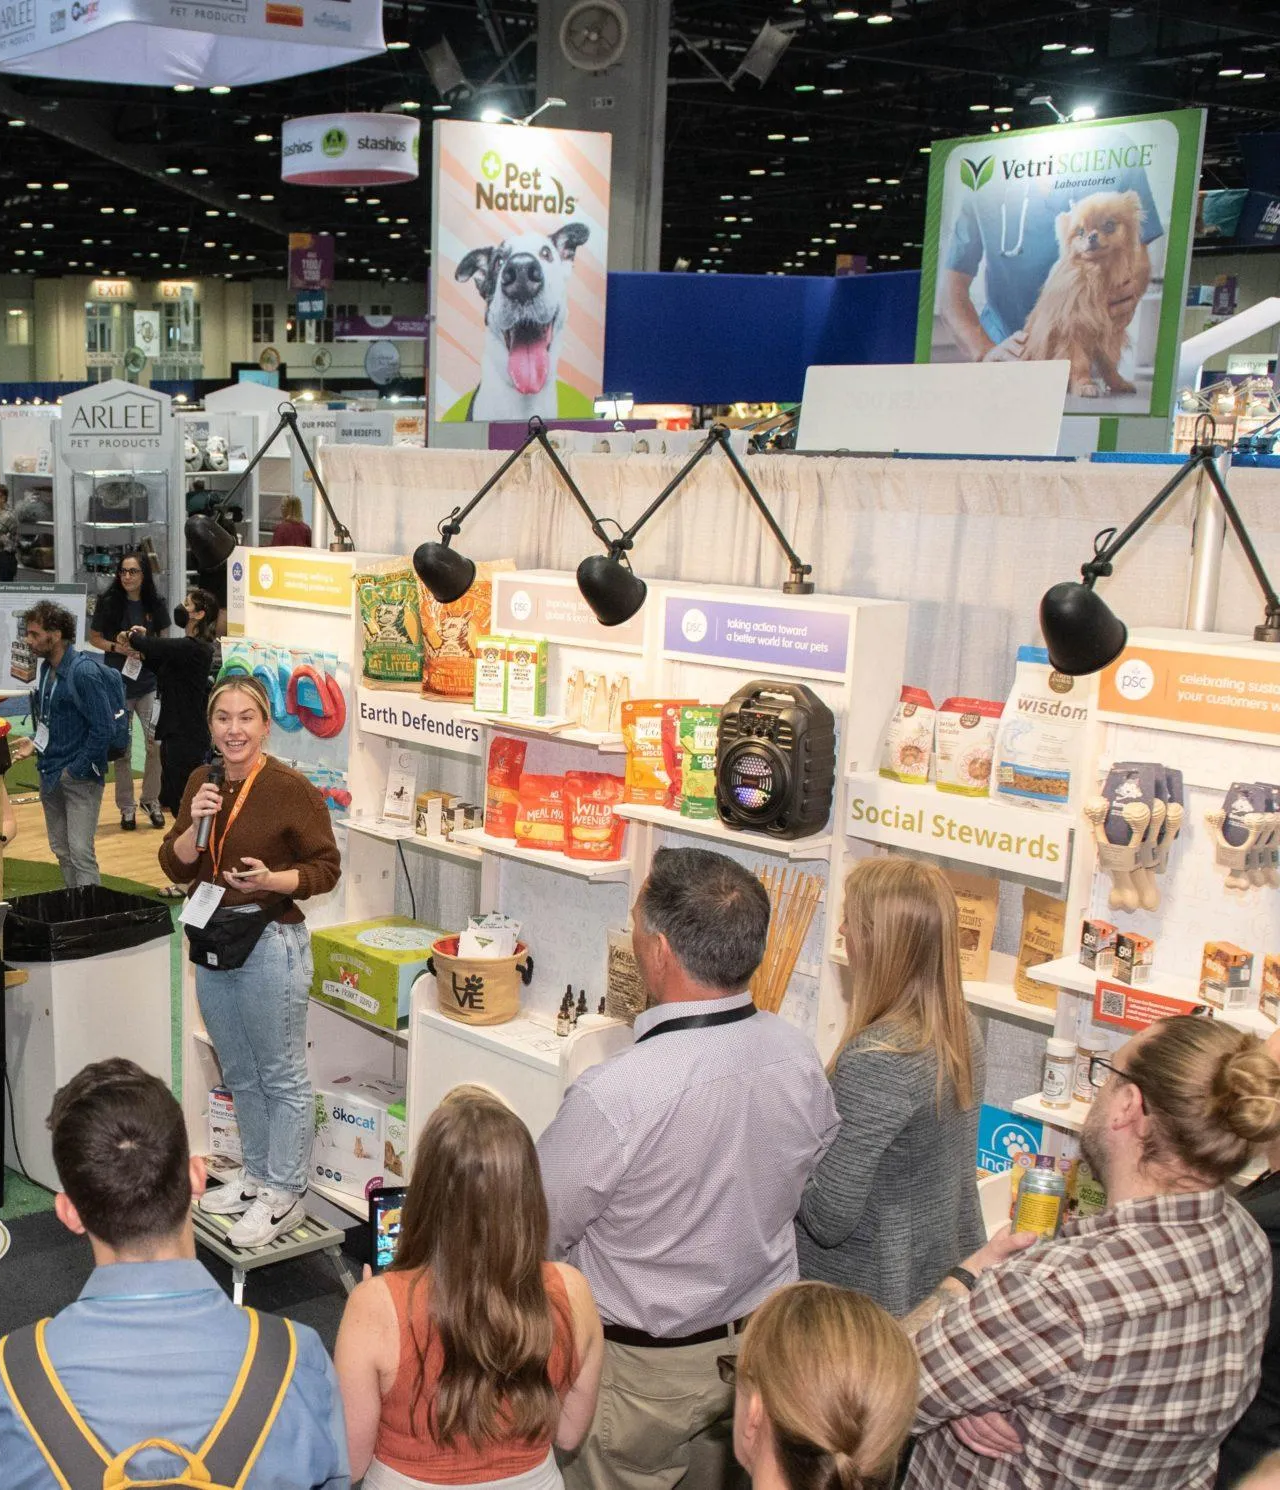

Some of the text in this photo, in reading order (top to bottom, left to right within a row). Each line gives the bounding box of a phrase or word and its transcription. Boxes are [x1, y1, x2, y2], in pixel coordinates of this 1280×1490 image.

[170, 7, 247, 24] PET PRODUCTS
[357, 136, 407, 152] stashios
[505, 163, 541, 190] Pet
[1054, 175, 1117, 190] Laboratories
[475, 176, 577, 214] Naturals
[98, 286, 126, 297] EXIT
[71, 404, 157, 430] ARLEE
[302, 421, 316, 429] OUR
[341, 429, 353, 437] OUR
[71, 439, 161, 449] PET PRODUCTS
[727, 618, 808, 637] taking action toward
[726, 633, 829, 655] a better world for our pets
[385, 660, 419, 673] LITTER
[1121, 675, 1147, 690] psc
[1179, 673, 1246, 693] celebrating
[1177, 689, 1207, 703] your
[1206, 694, 1269, 711] customers
[1017, 698, 1088, 721] wisdom
[360, 702, 479, 742] Earth Defenders
[527, 808, 550, 821] MEAL
[577, 797, 612, 816] WILD
[572, 811, 612, 826] WEENIES
[851, 797, 1061, 863] Social Stewards
[1083, 932, 1097, 944] go!
[1119, 945, 1133, 958] go!
[332, 1105, 376, 1131] ökocat
